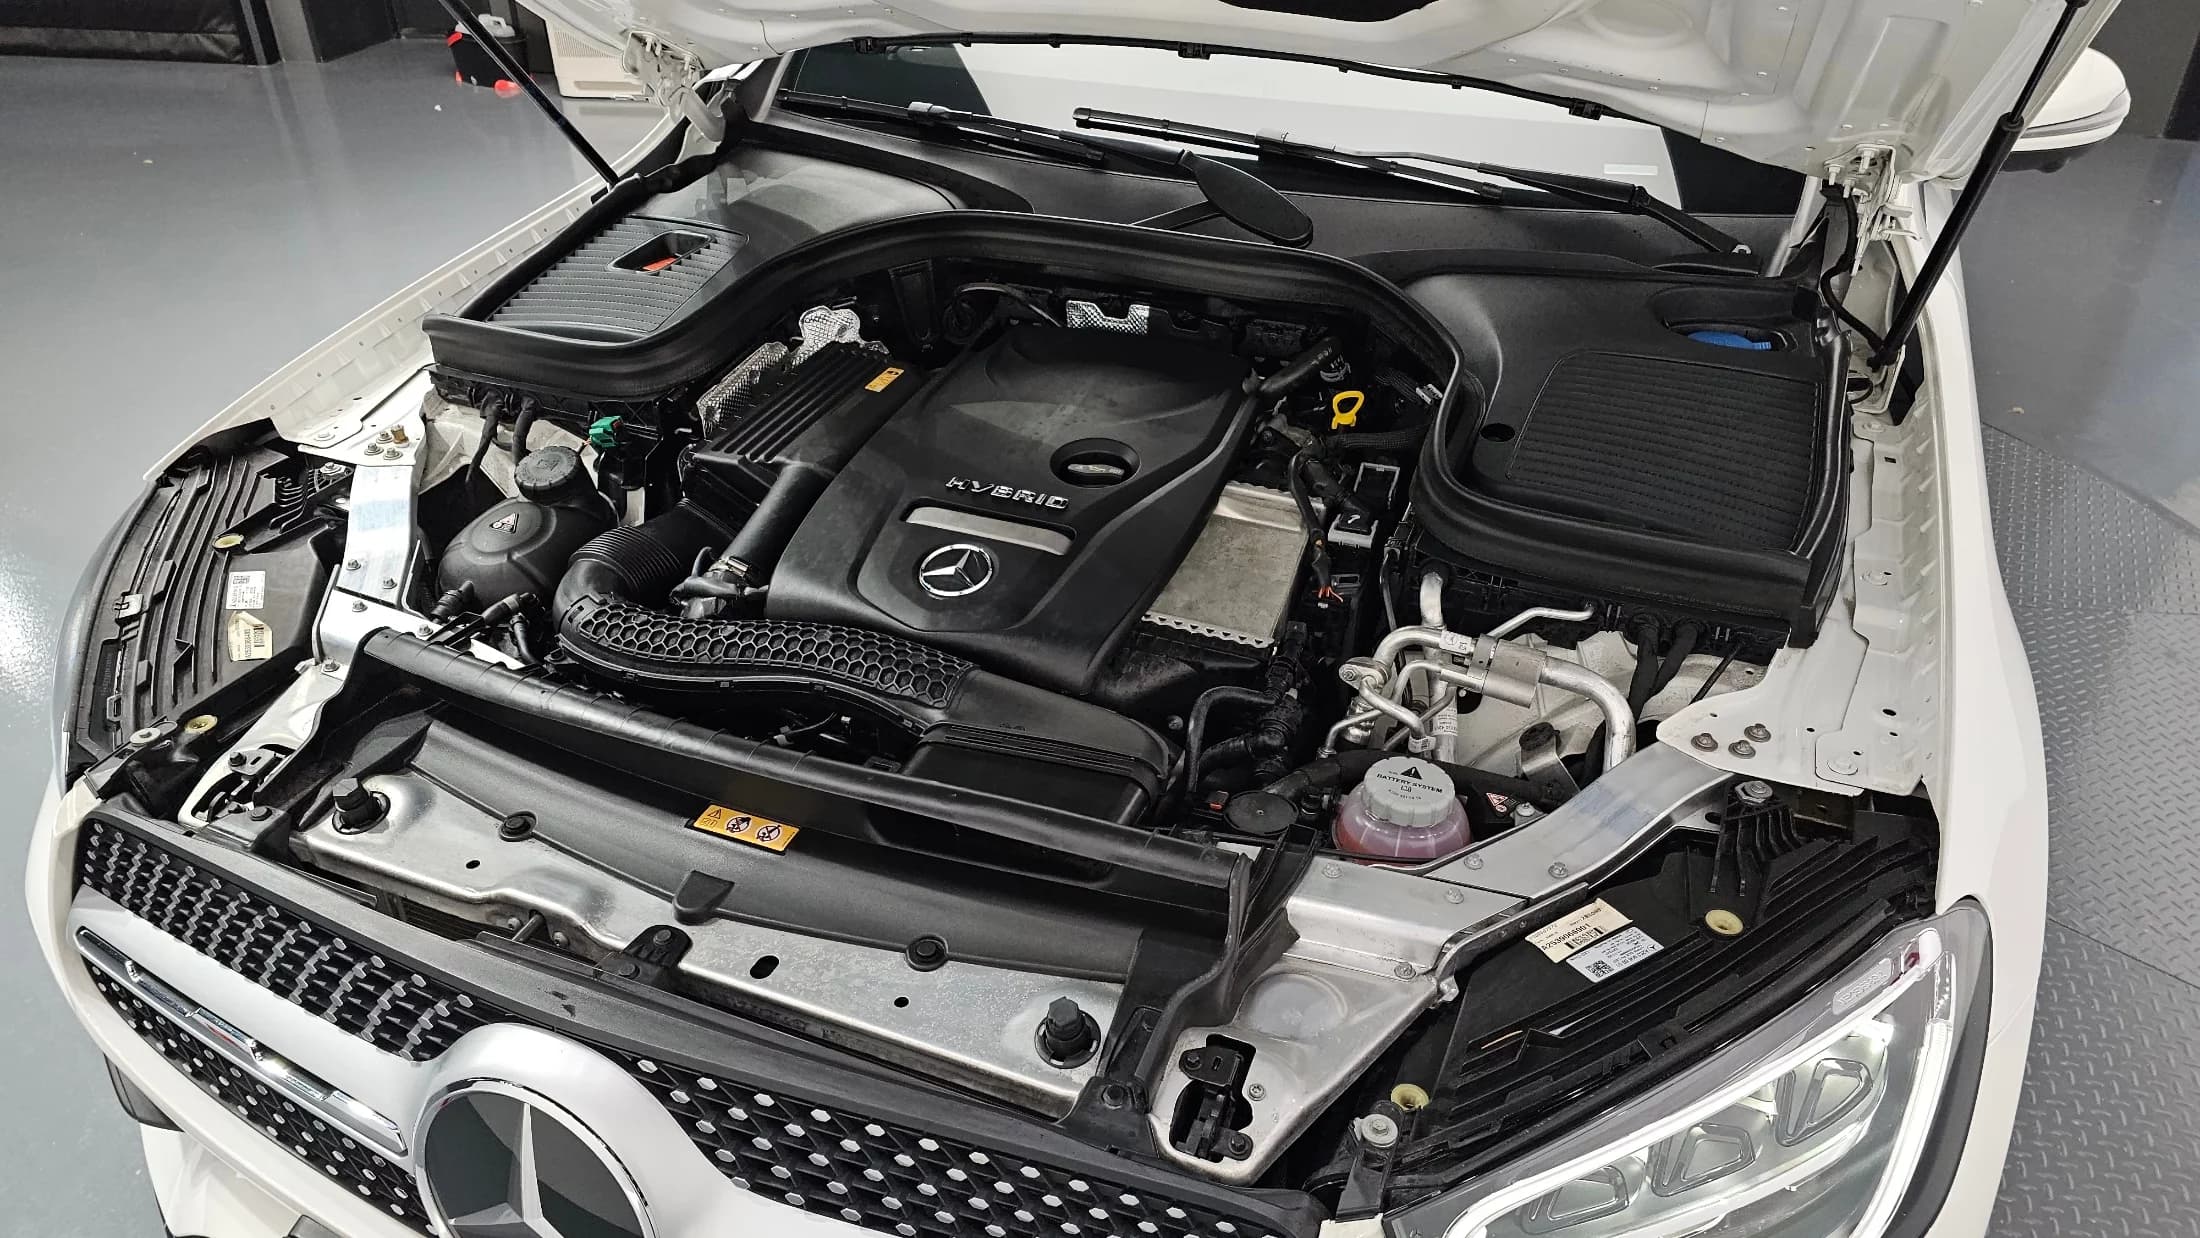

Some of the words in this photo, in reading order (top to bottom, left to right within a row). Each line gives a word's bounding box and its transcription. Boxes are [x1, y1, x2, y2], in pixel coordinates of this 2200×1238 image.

[945, 476, 1069, 509] HYBRID
[1376, 773, 1410, 785] BATTERY
[1412, 782, 1443, 793] SYSTEM
